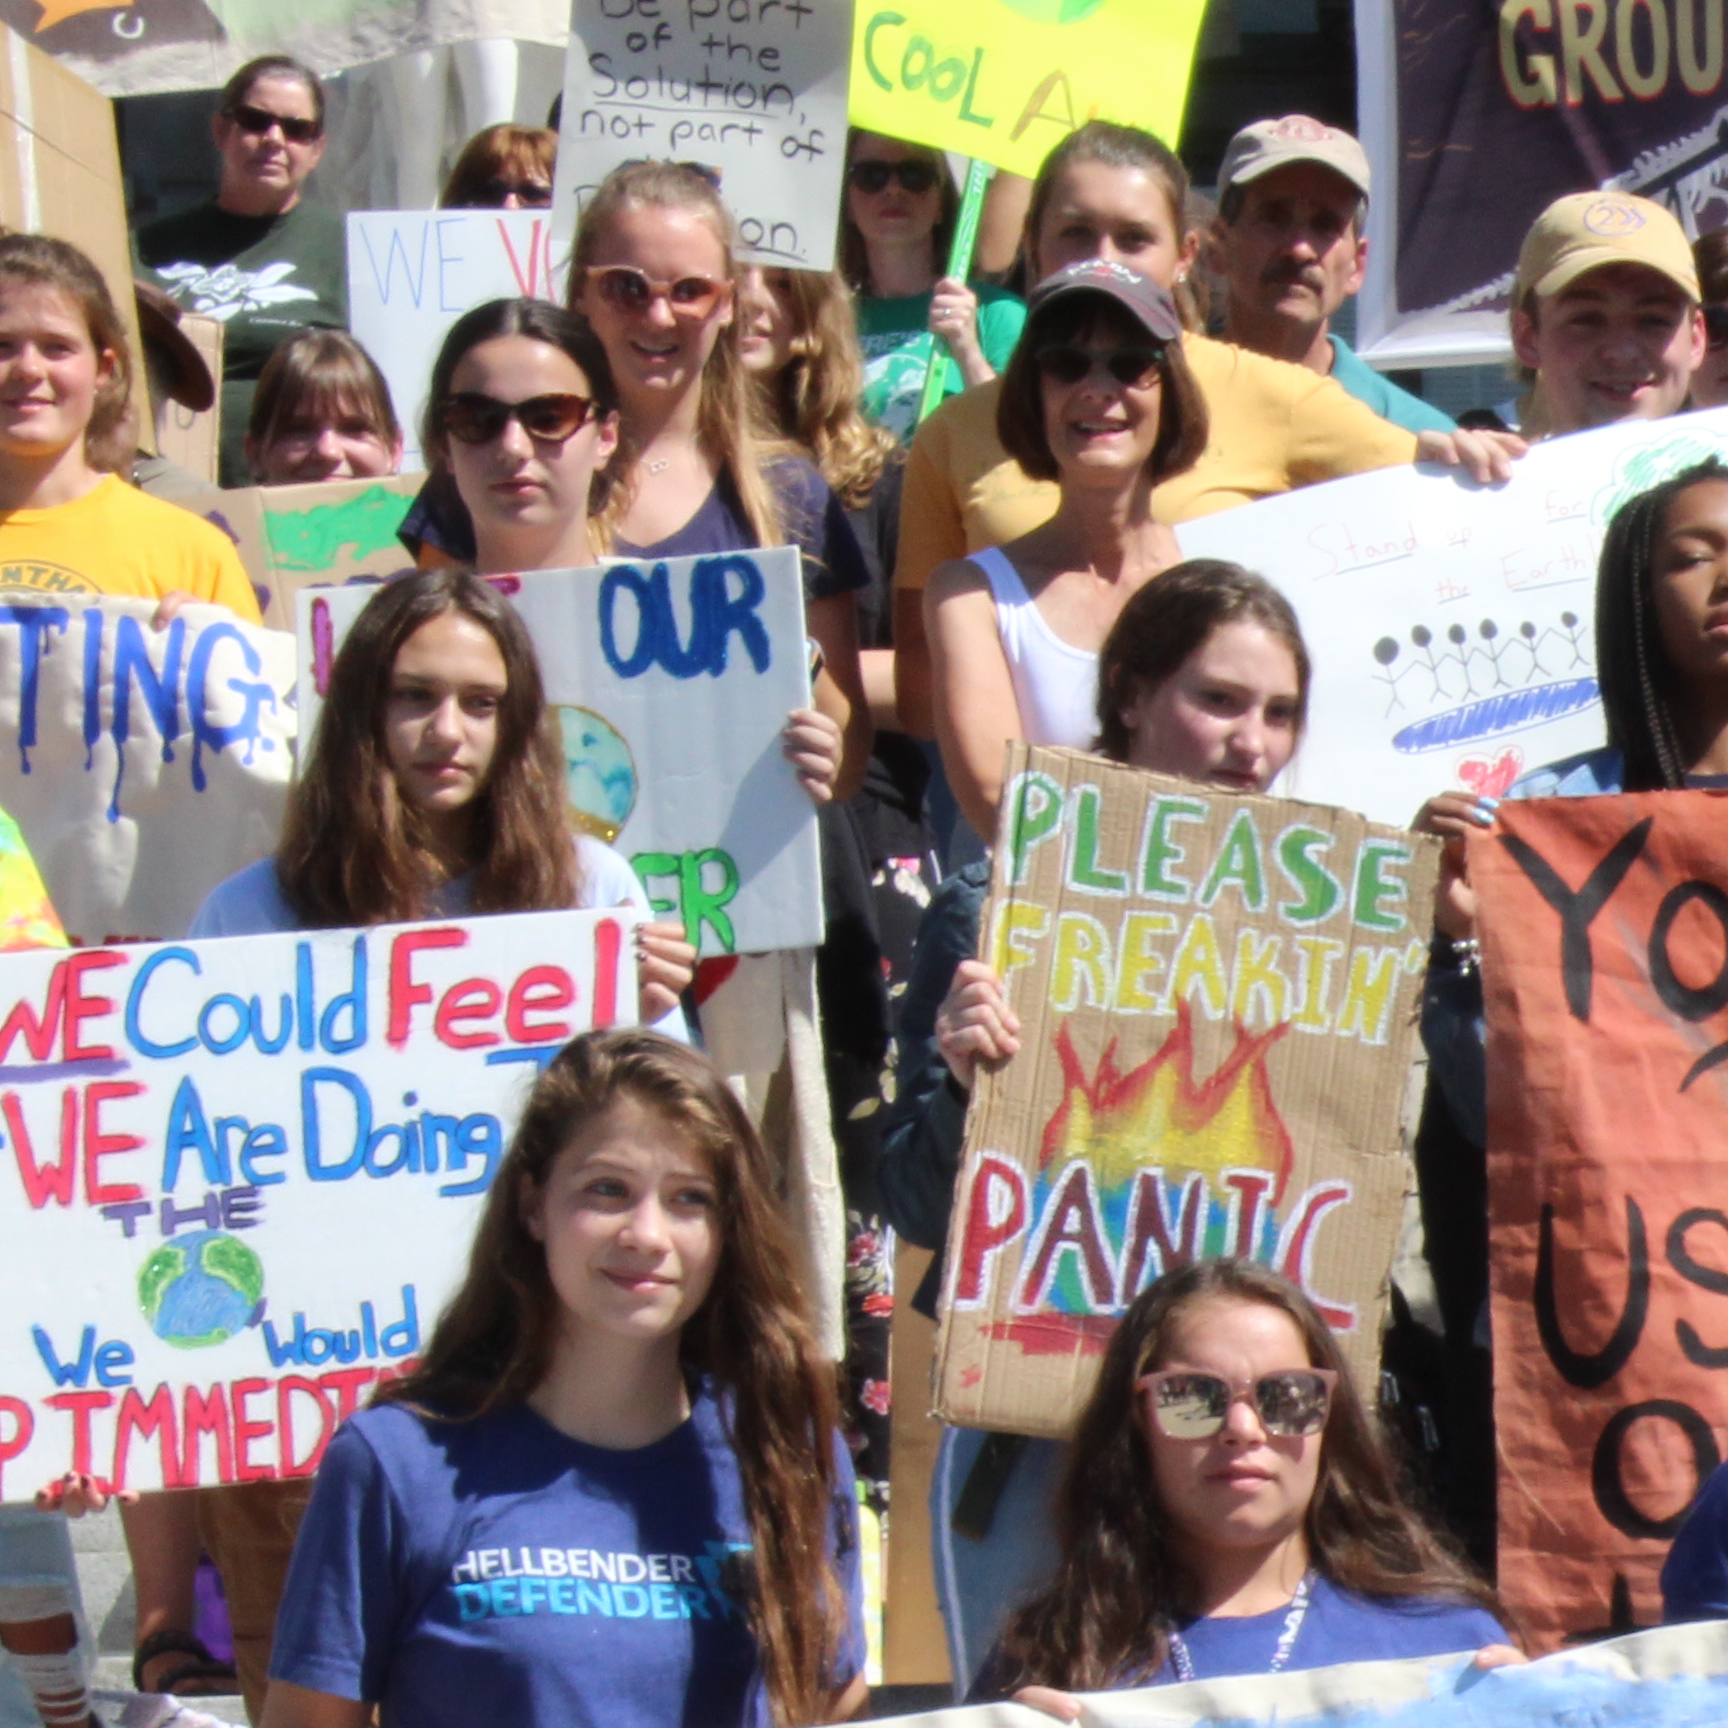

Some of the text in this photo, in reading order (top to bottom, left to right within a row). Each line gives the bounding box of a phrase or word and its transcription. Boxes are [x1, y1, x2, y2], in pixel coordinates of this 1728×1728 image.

[589, 53, 806, 125] Solution,
[626, 22, 781, 71] of the
[864, 11, 994, 129] COOL
[581, 109, 824, 161] not part of
[360, 218, 467, 312] WE
[599, 555, 771, 679] OUR
[1006, 770, 1411, 932] PLEASE
[125, 935, 368, 1058] Could
[387, 919, 620, 1052] Feel
[2, 1066, 504, 1209] WE Are Doing
[100, 1187, 268, 1238] THE
[948, 1149, 1357, 1331] PANIC
[32, 1284, 420, 1388] We Would
[452, 1547, 695, 1584] HELLBENDER
